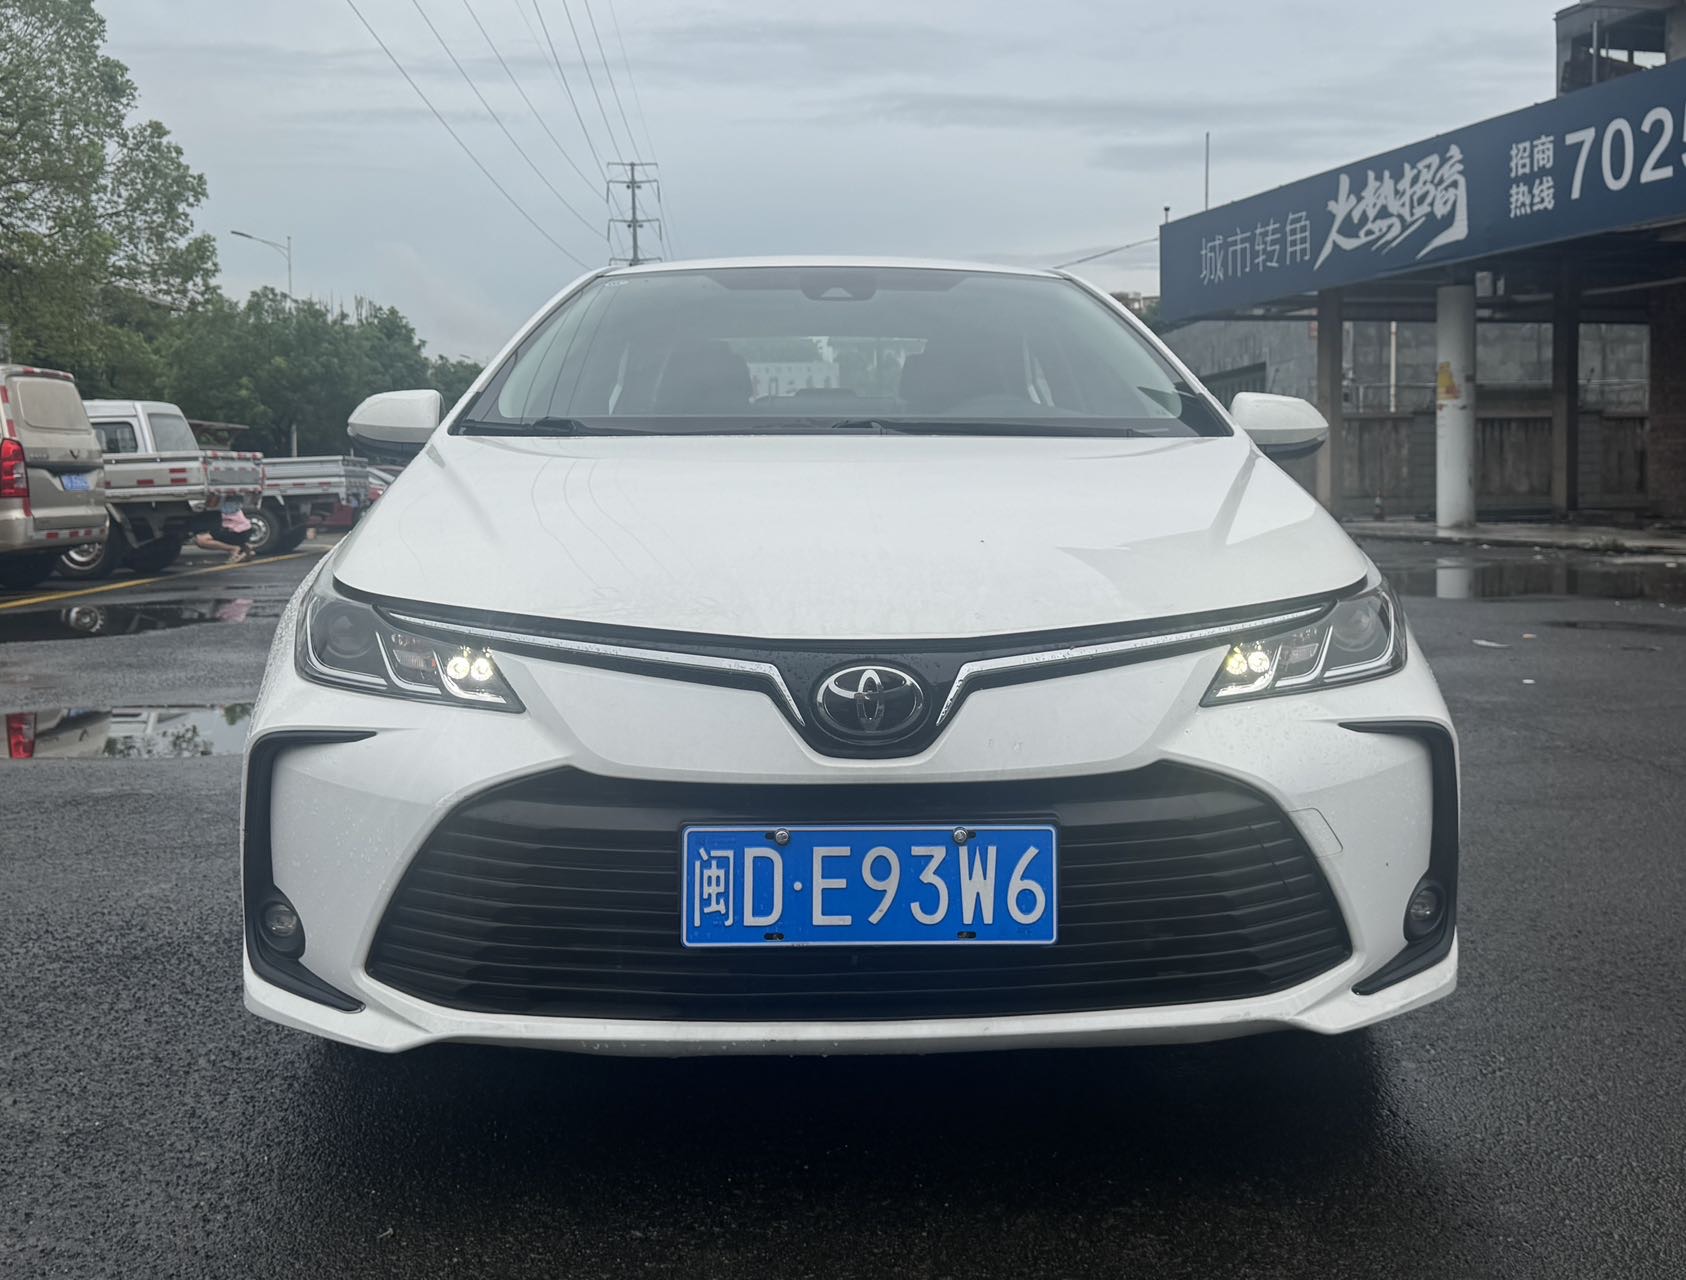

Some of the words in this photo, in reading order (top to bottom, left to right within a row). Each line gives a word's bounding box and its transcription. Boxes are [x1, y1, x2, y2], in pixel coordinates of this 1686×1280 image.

[1509, 134, 1555, 179] 招商
[1564, 101, 1686, 200] 702
[1509, 176, 1556, 219] 热线
[1199, 210, 1311, 285] 城市转角
